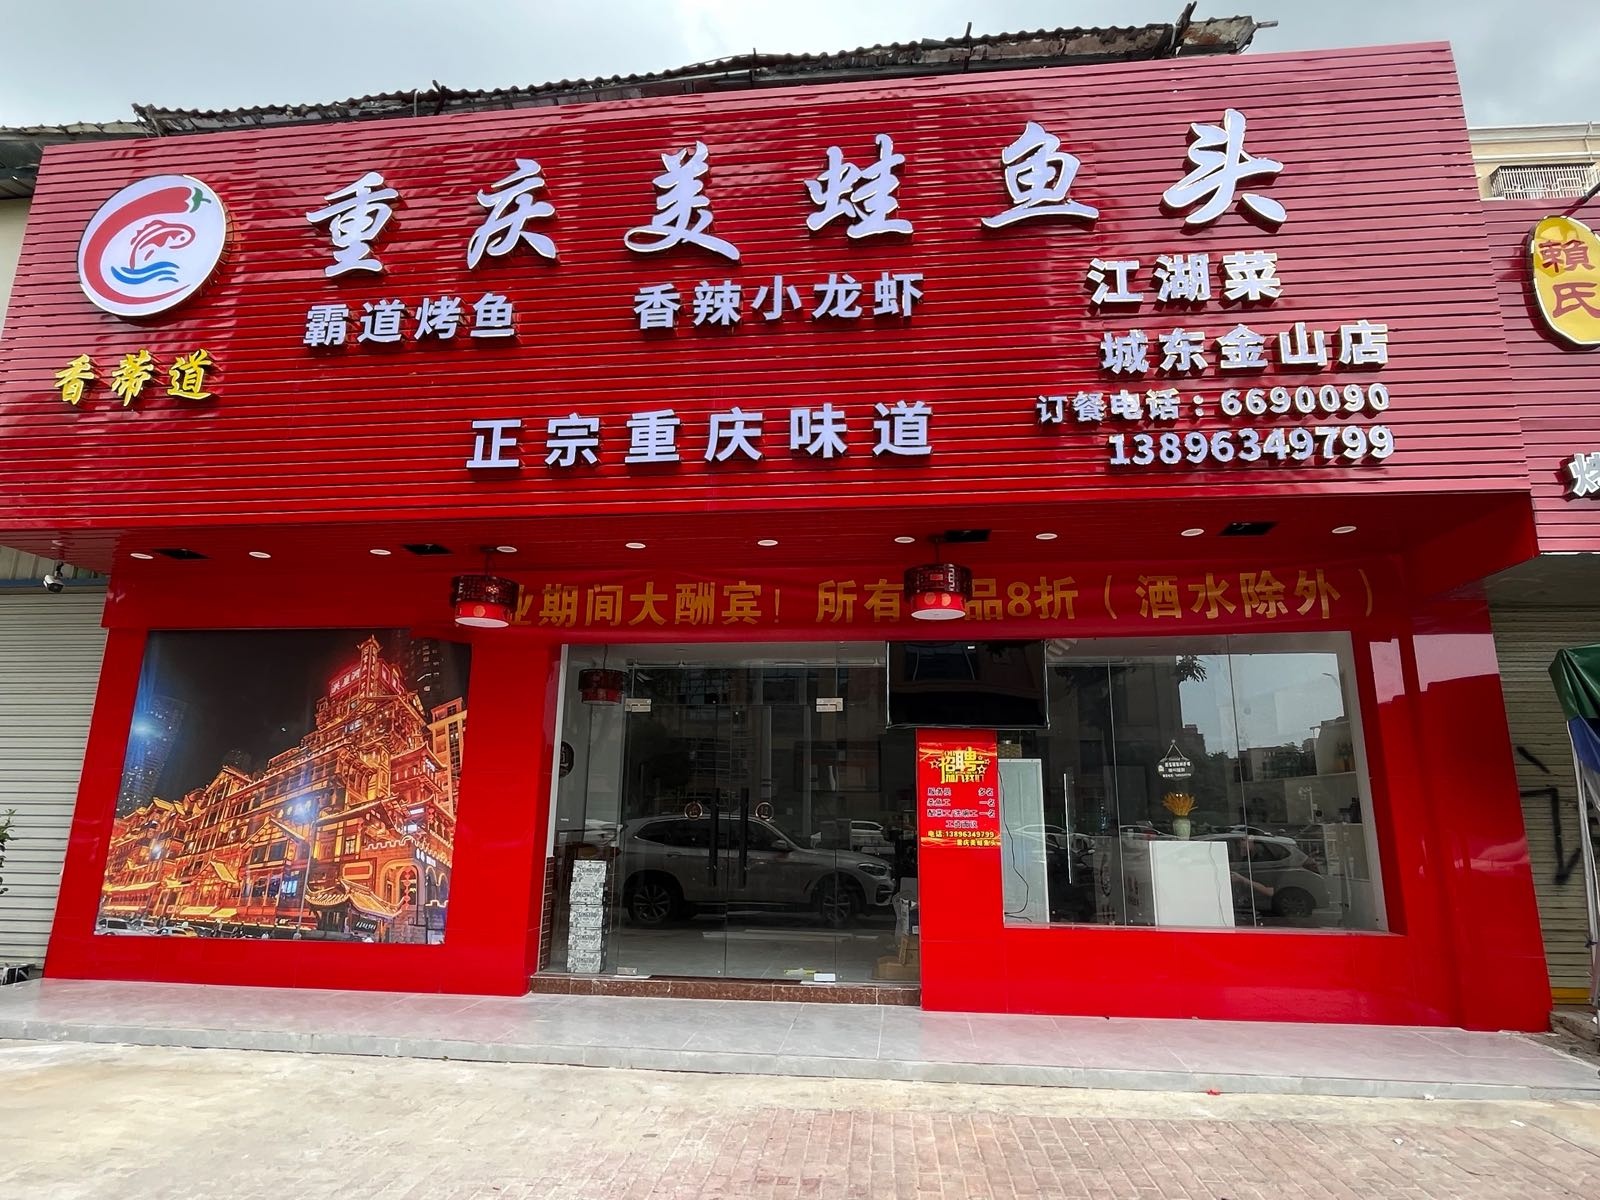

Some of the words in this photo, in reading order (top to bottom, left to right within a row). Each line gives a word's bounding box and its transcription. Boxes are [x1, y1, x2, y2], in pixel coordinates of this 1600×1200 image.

[306, 108, 1288, 278] 重庆美蛙鱼头
[633, 272, 925, 330] 香辣小龙虾
[1086, 251, 1282, 304] 江湖菜
[303, 292, 516, 347] 霸道烤鱼
[1100, 320, 1390, 374] 城东金山店
[466, 401, 932, 469] 正宗重庆味道
[1109, 425, 1395, 466] 13896349799
[939, 747, 985, 782] 招聘
